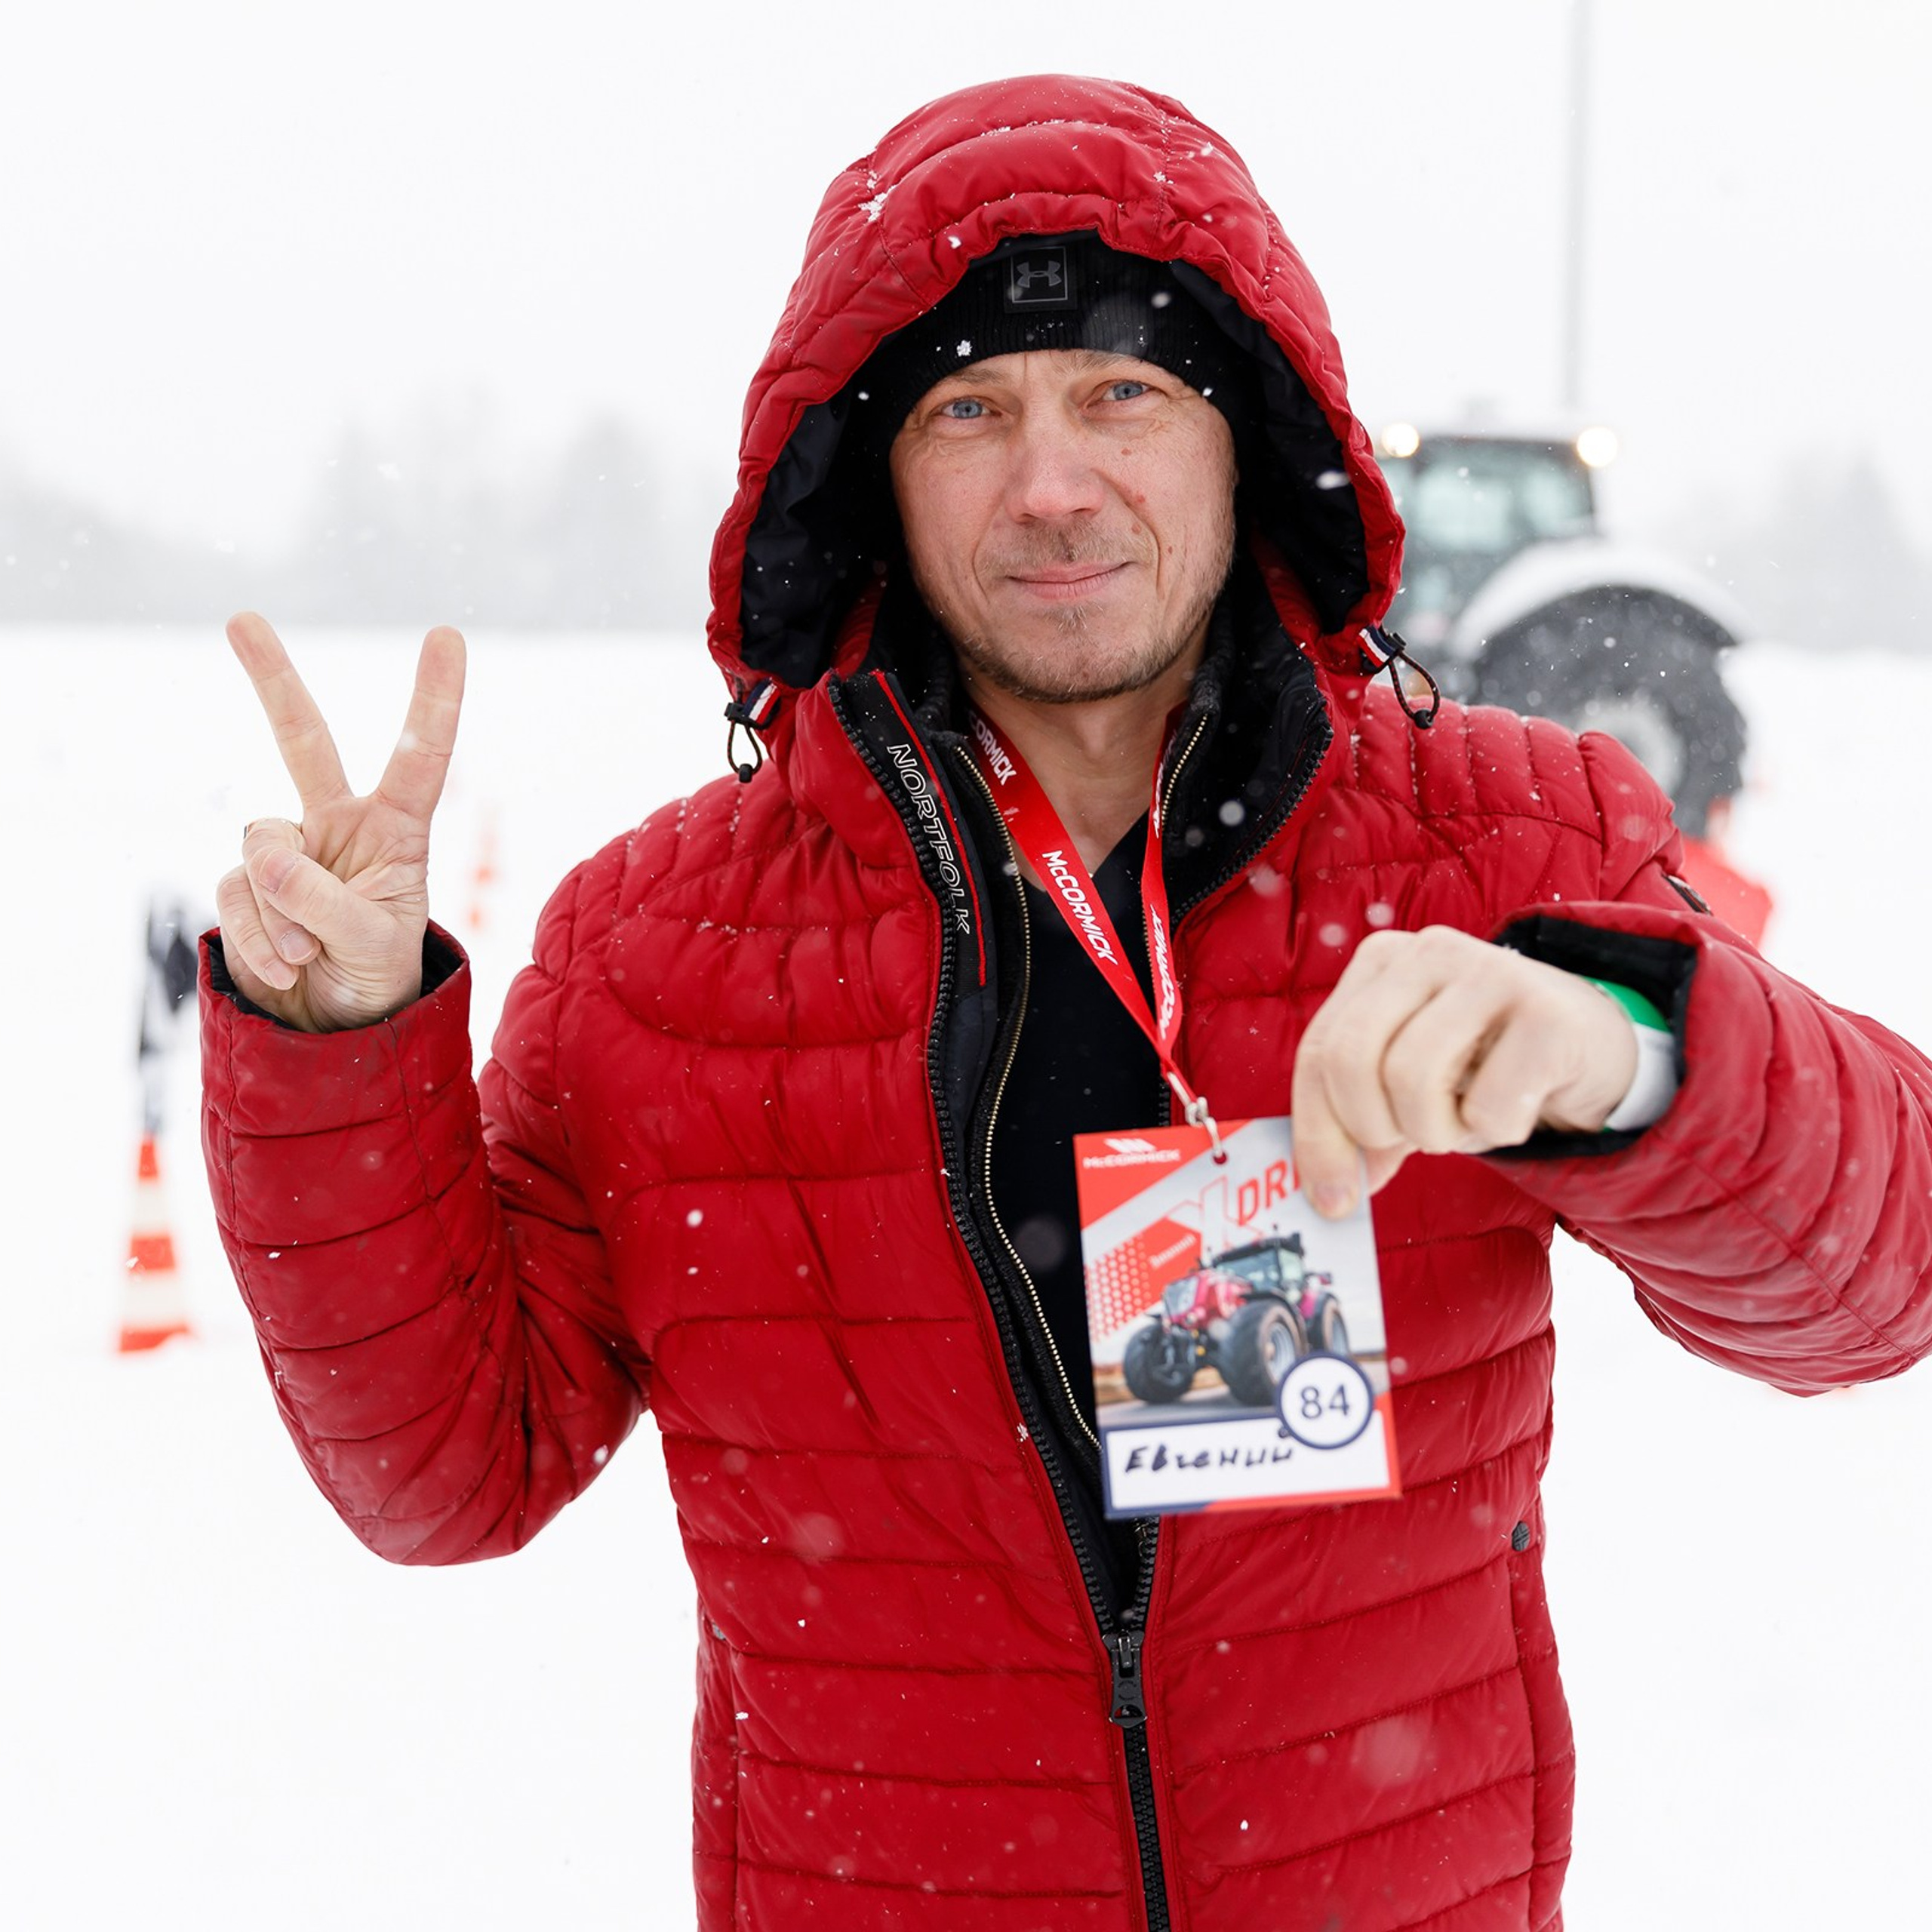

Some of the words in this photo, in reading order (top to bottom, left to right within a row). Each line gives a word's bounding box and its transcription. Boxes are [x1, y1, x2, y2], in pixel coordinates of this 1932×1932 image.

[968, 709, 1017, 786] CORMICK
[887, 743, 971, 934] NORTFOLK
[1042, 850, 1118, 966] McCORMICK
[1237, 1152, 1301, 1227] DRI
[1300, 1384, 1350, 1420] 84
